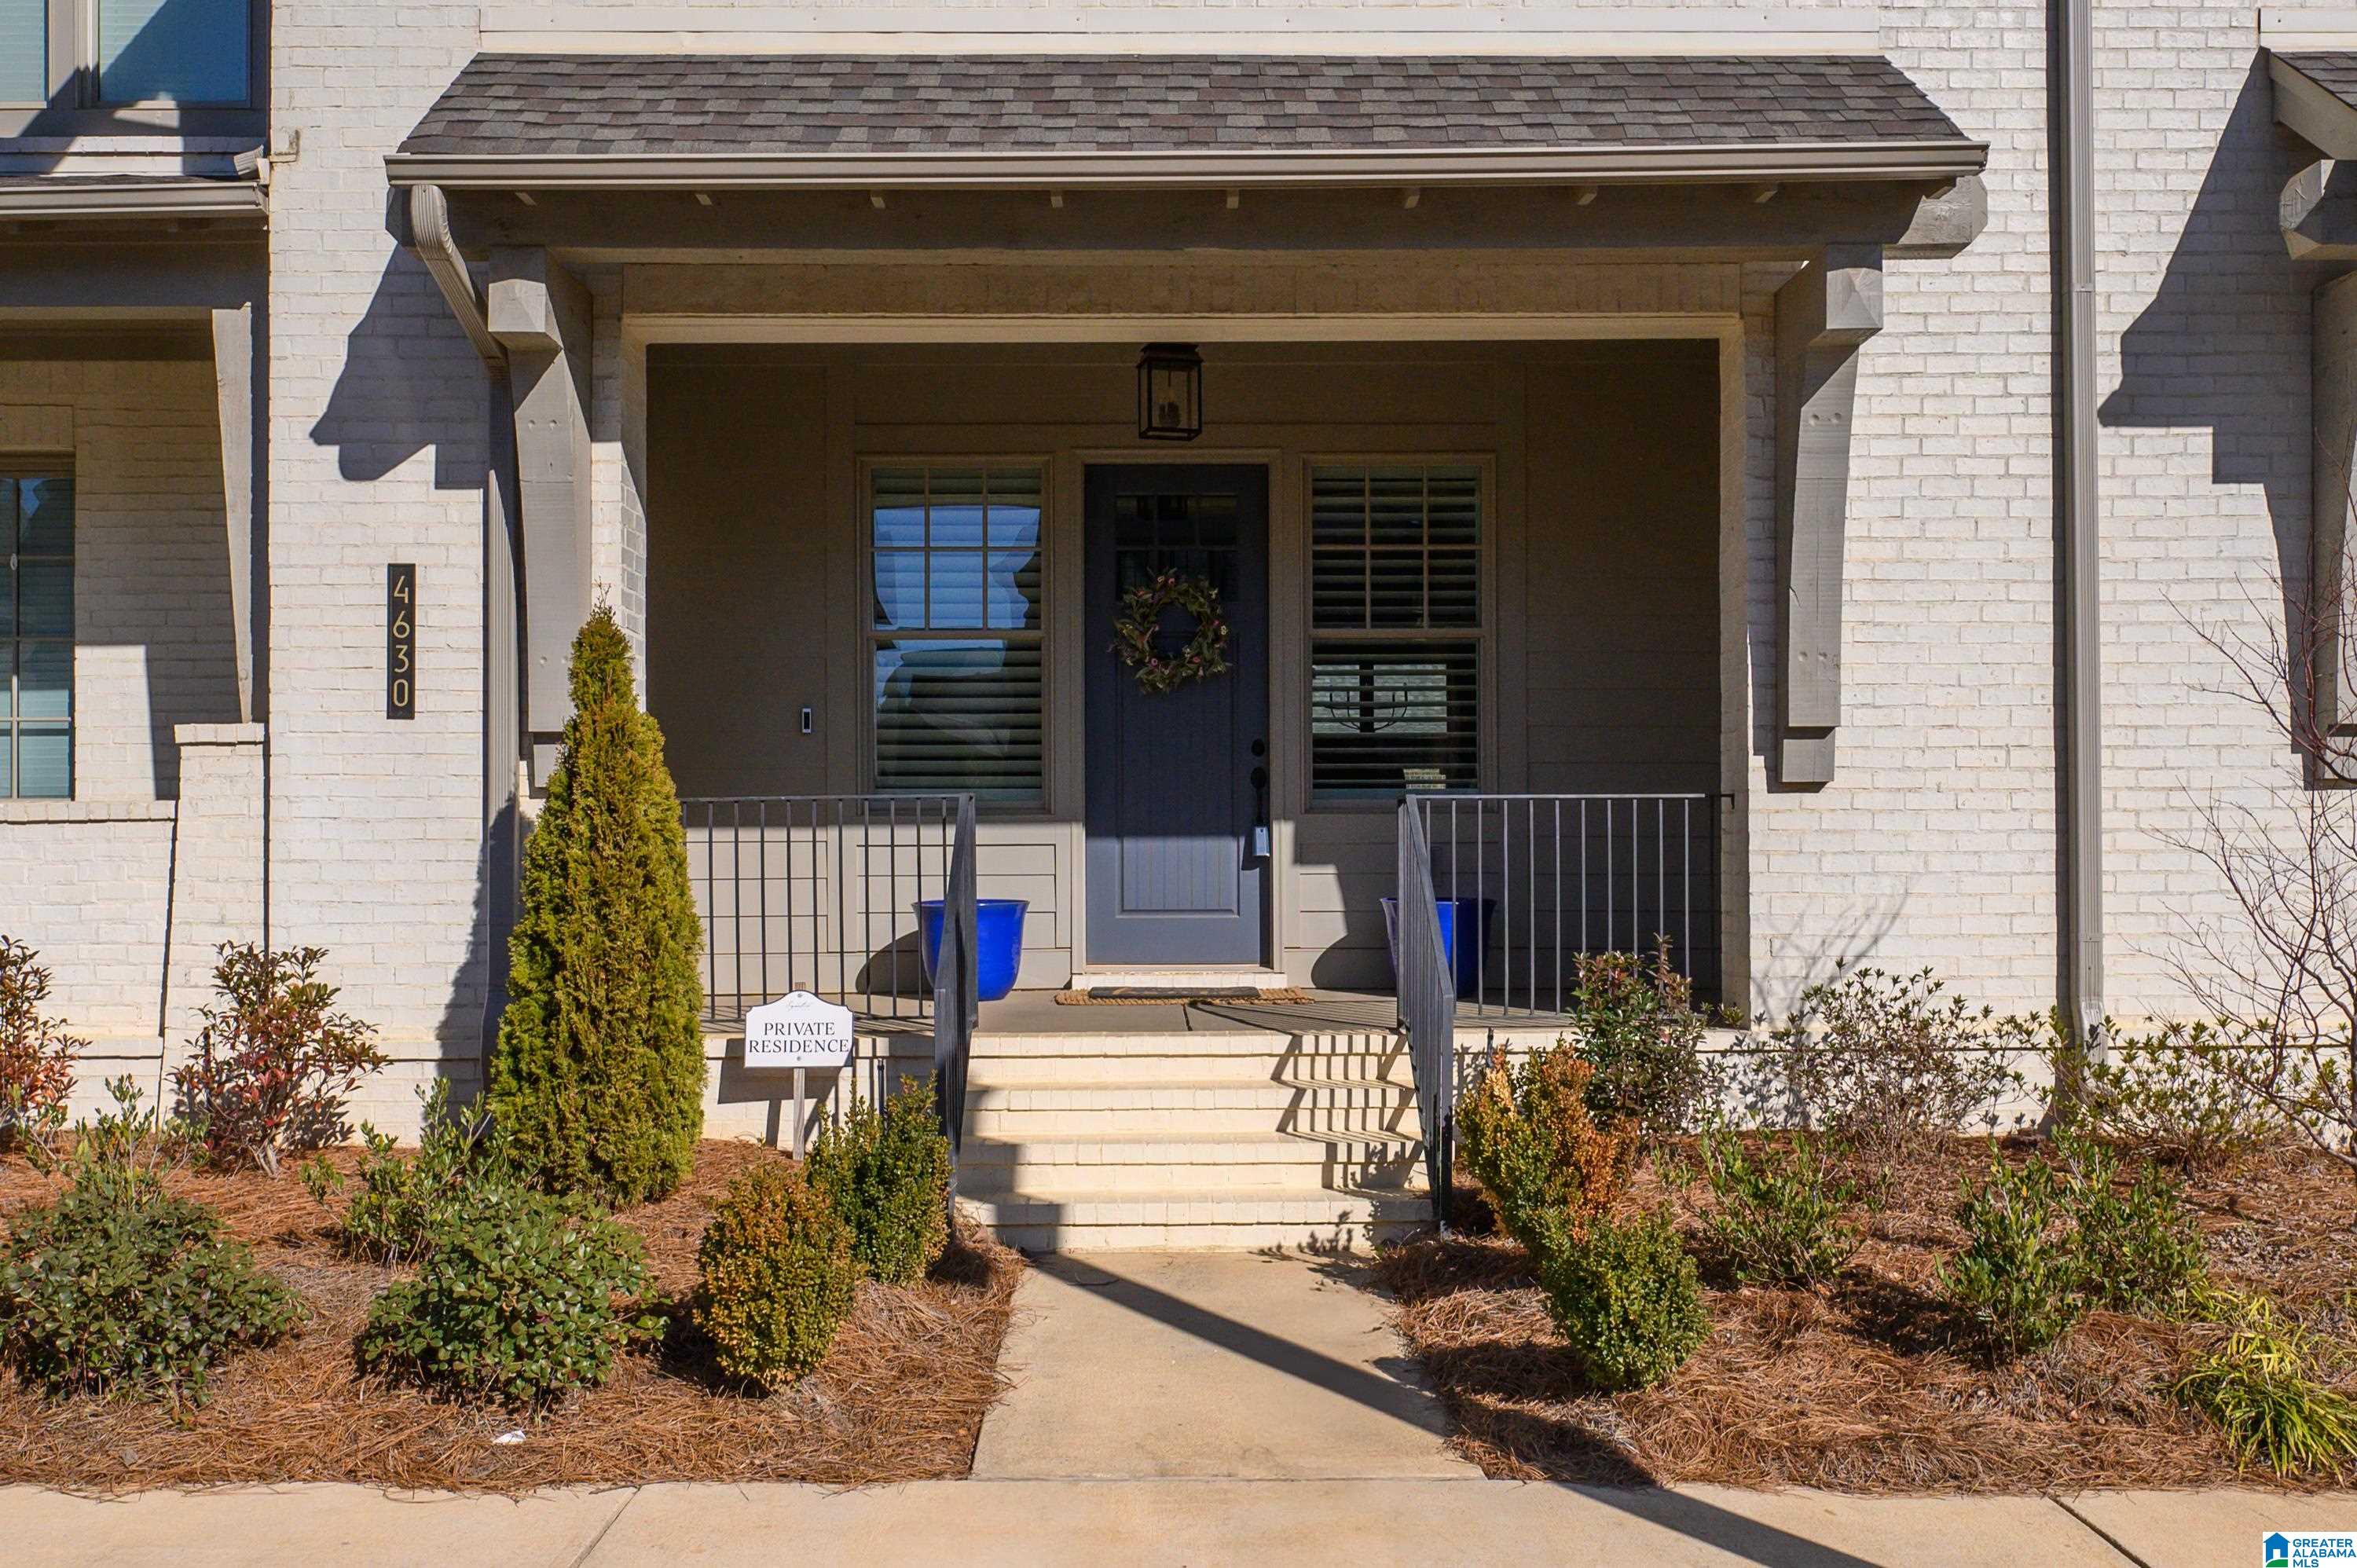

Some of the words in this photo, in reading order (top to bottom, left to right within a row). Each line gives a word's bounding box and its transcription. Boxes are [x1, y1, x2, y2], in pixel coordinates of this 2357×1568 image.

[393, 576, 410, 707] 4630
[764, 1022, 835, 1035] PRIVATE
[749, 1039, 849, 1053] RESIDENCE
